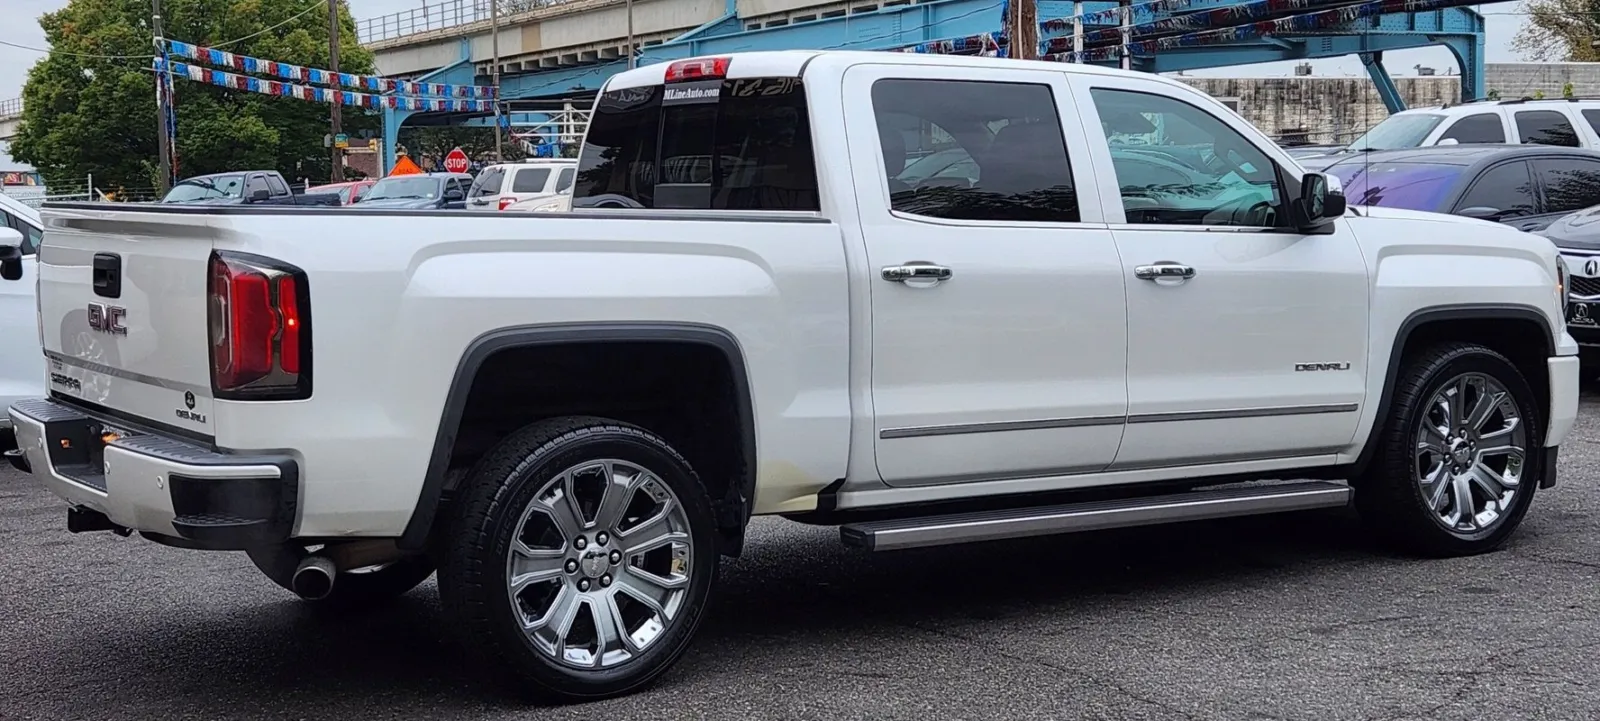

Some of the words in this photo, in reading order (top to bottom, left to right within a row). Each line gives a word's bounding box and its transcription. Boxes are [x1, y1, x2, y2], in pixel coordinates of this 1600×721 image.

[663, 87, 720, 100] MLineAuto.com
[448, 159, 466, 168] STOP
[88, 302, 127, 337] GMC
[1295, 361, 1351, 372] DENALI
[175, 409, 206, 424] DENALI
